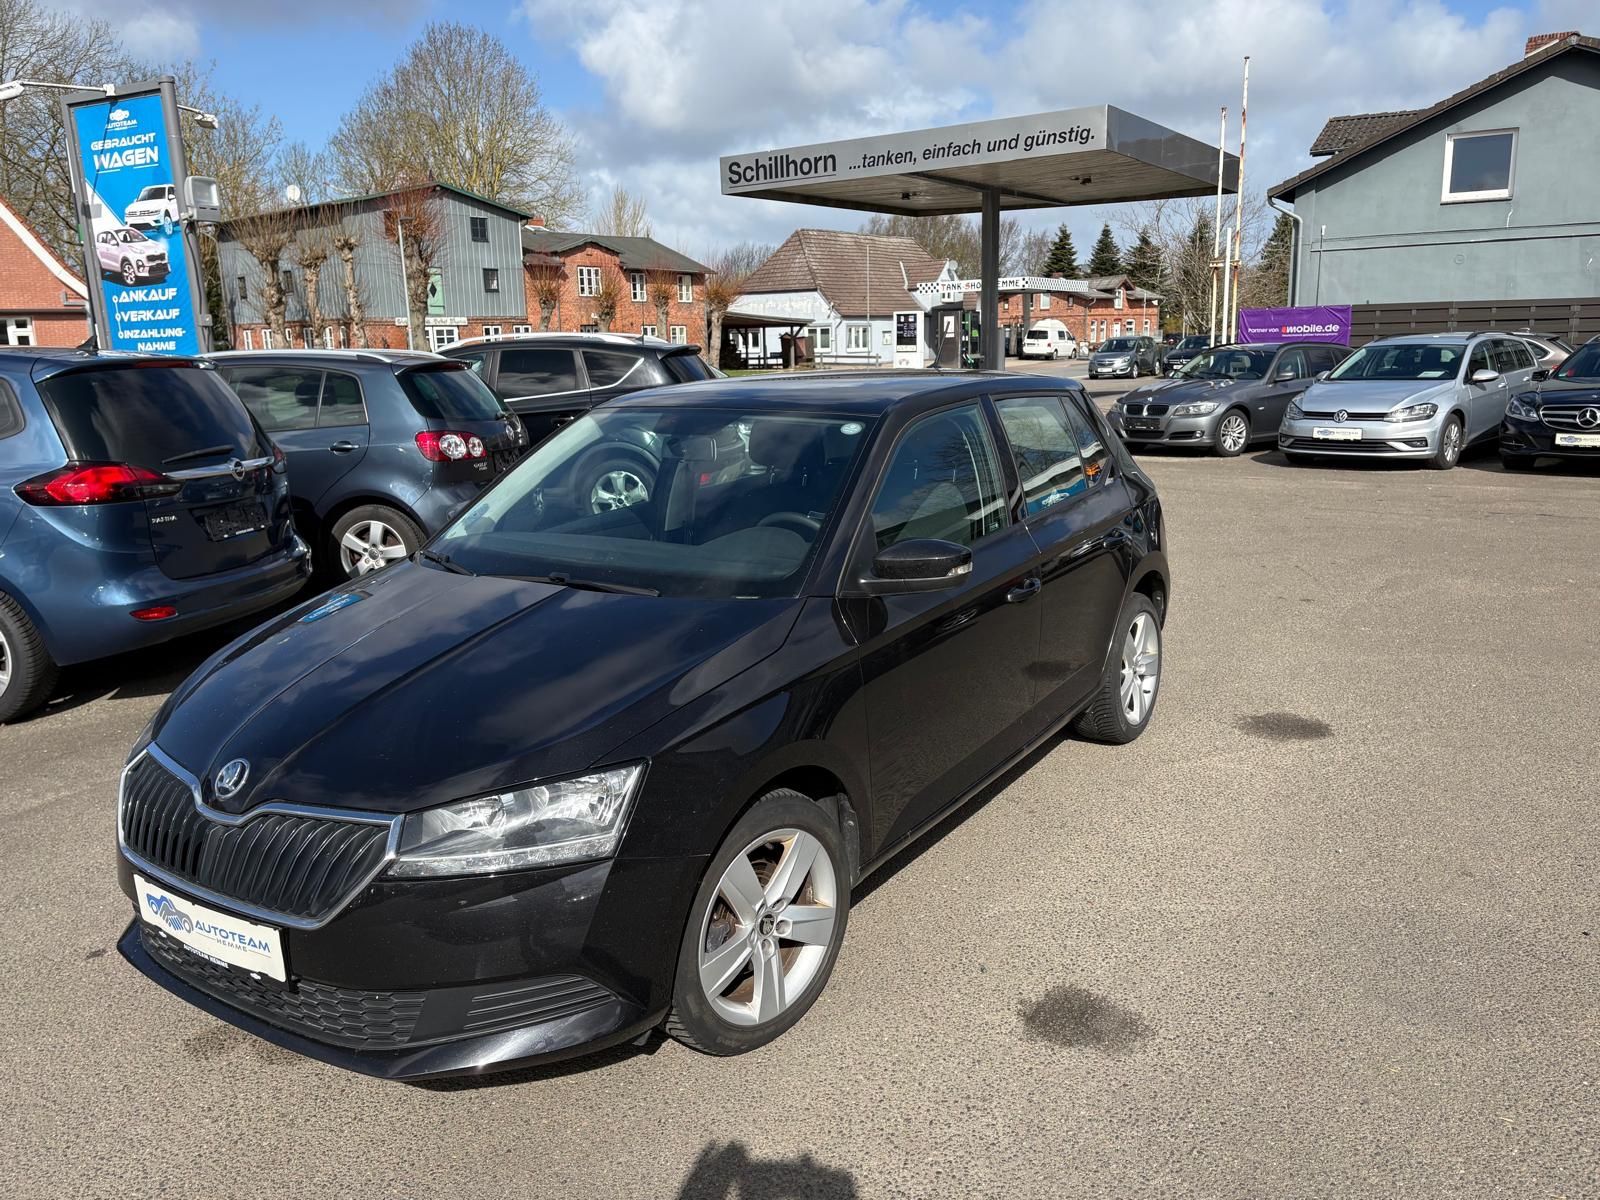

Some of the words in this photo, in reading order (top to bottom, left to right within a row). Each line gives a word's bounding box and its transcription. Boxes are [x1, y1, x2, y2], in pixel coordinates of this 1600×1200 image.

[90, 132, 157, 151] GEBRAUCHT
[922, 138, 982, 161] einfach
[986, 133, 1020, 153] und
[1023, 125, 1095, 152] günstig.
[93, 145, 159, 170] WAGEN
[728, 154, 837, 185] Schillhorn
[118, 287, 178, 303] ANKAUF
[120, 308, 180, 322] VERKAUF
[1283, 324, 1339, 333] mobile.de
[137, 341, 177, 352] NAHME
[194, 919, 271, 953] AUTOTEAM
[216, 938, 248, 953] HEMME
